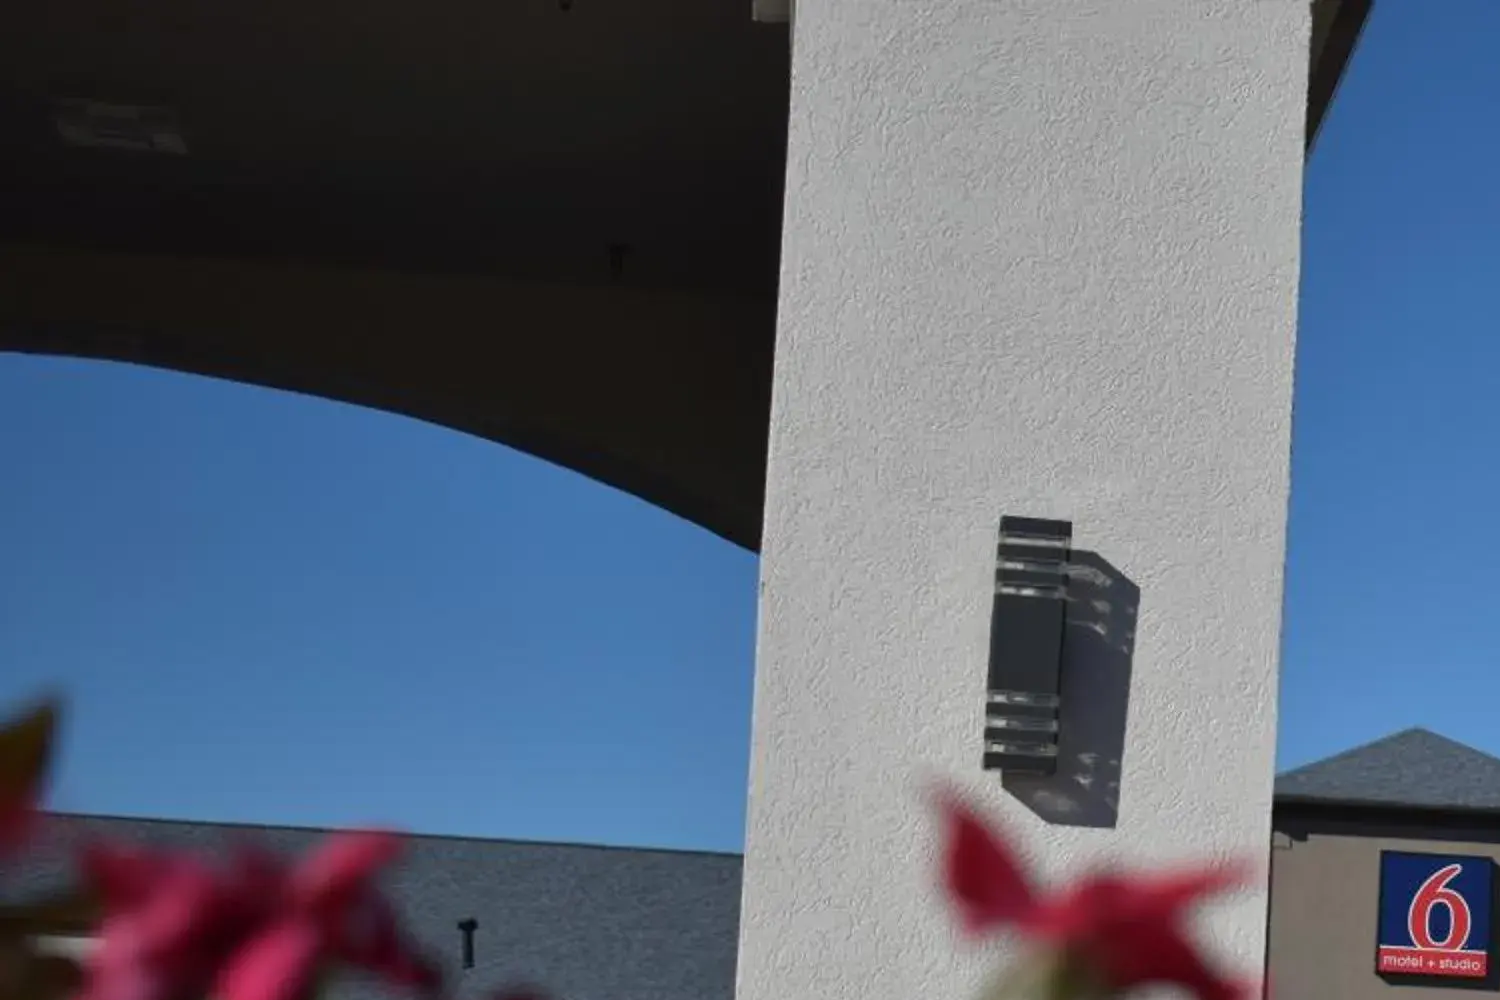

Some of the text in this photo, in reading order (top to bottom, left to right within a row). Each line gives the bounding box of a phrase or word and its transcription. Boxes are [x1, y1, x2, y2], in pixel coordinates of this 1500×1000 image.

[1407, 863, 1472, 952] 6
[1383, 954, 1424, 968] motel
[1439, 957, 1481, 971] studio
